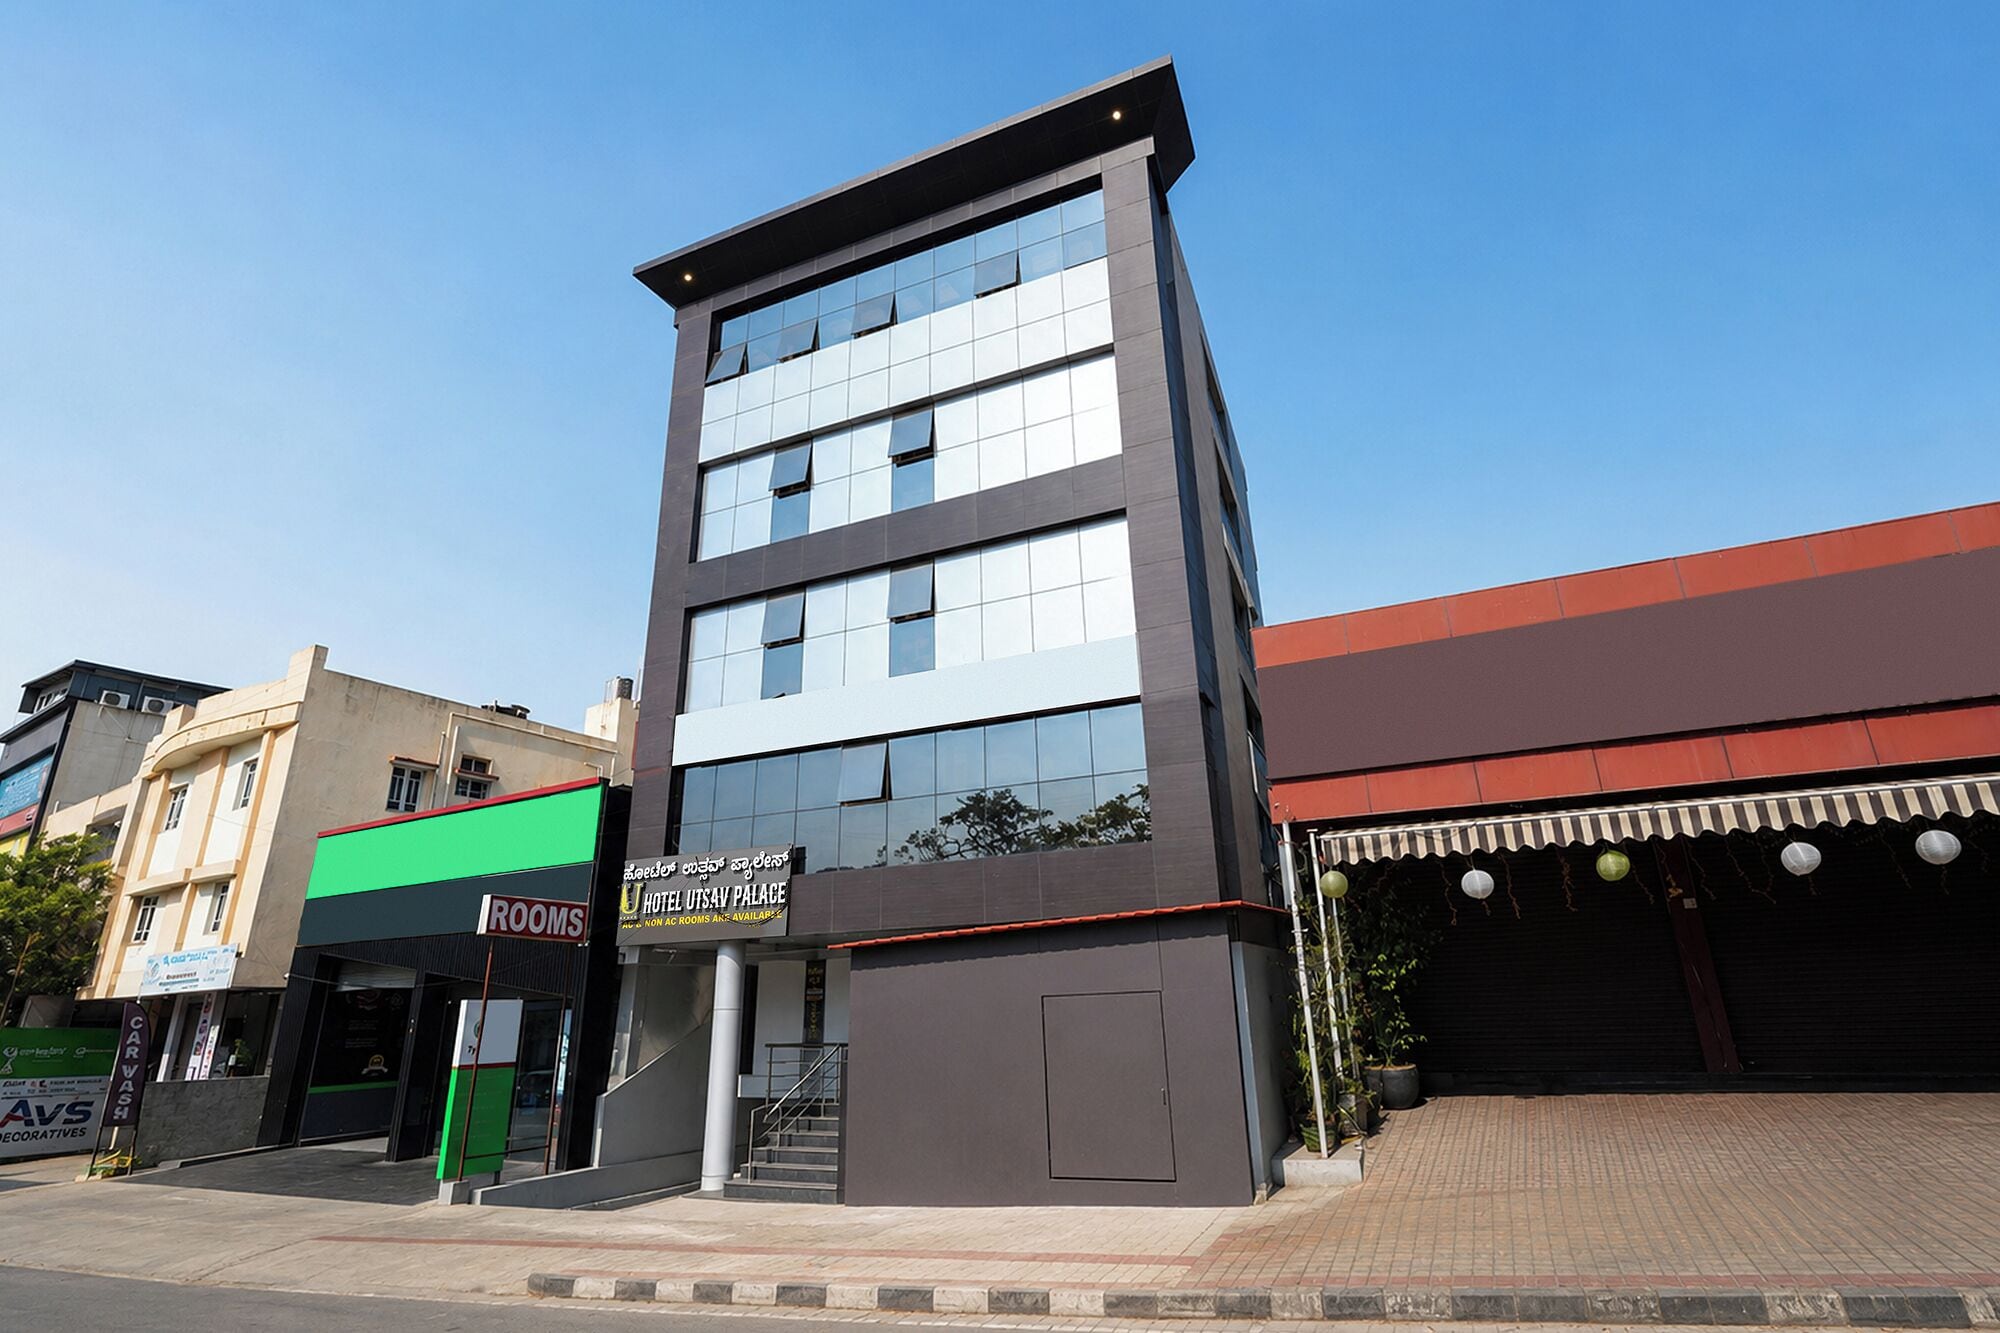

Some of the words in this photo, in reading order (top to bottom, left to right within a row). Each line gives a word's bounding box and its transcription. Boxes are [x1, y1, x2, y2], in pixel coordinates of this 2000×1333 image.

[643, 890, 682, 914] HOTEL
[686, 886, 730, 910] UTSAV
[733, 881, 787, 907] PALACE
[489, 900, 584, 938] ROOMS
[645, 917, 663, 927] NON
[665, 916, 676, 926] AC
[679, 915, 710, 925] ROOMS
[125, 1016, 143, 1060] CAR
[112, 1064, 140, 1120] WASH
